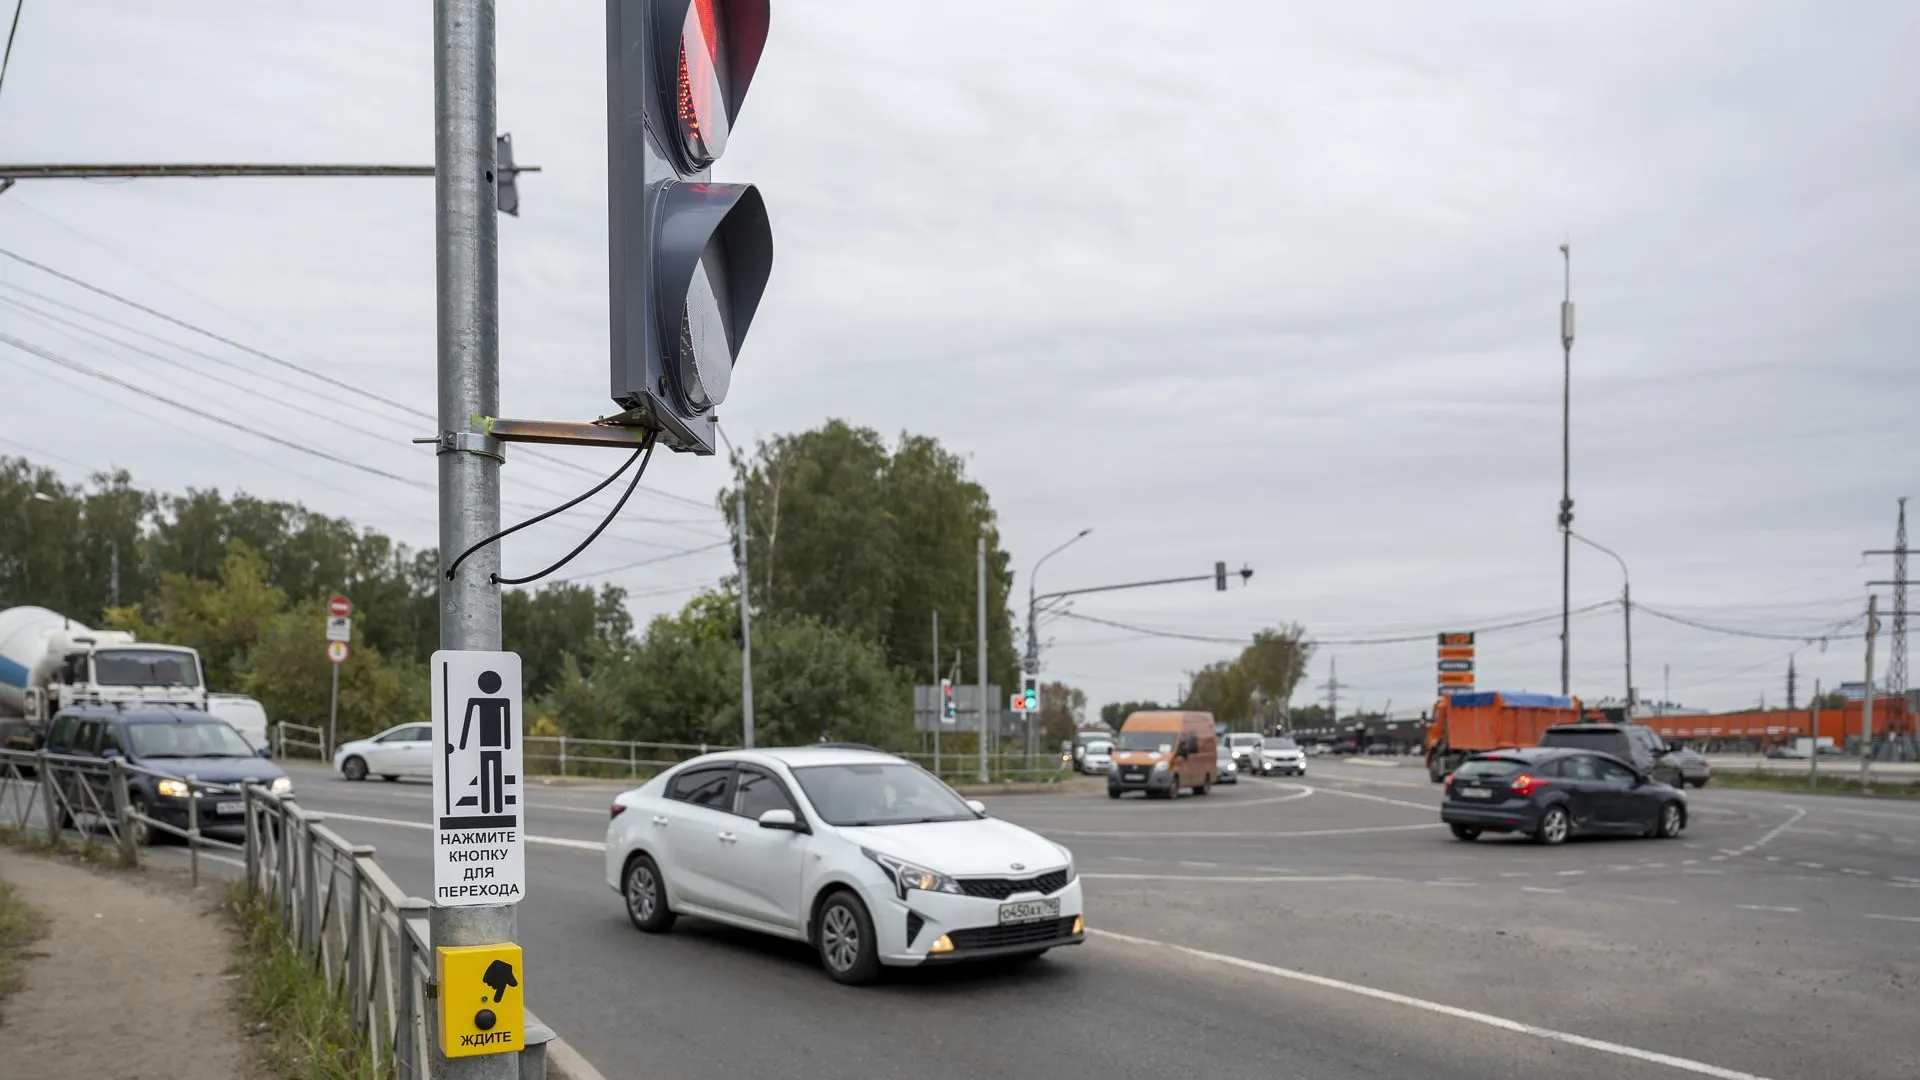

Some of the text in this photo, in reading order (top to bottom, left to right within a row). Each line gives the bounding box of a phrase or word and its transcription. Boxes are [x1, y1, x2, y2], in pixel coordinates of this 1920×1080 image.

[440, 832, 516, 845] НАЖМИТЕ
[449, 848, 509, 862] КНОПКУ
[463, 867, 494, 881] ДЛЯ
[439, 884, 520, 898] ПЕРЕХОДА
[460, 1031, 512, 1047] ЖДИТЕ
